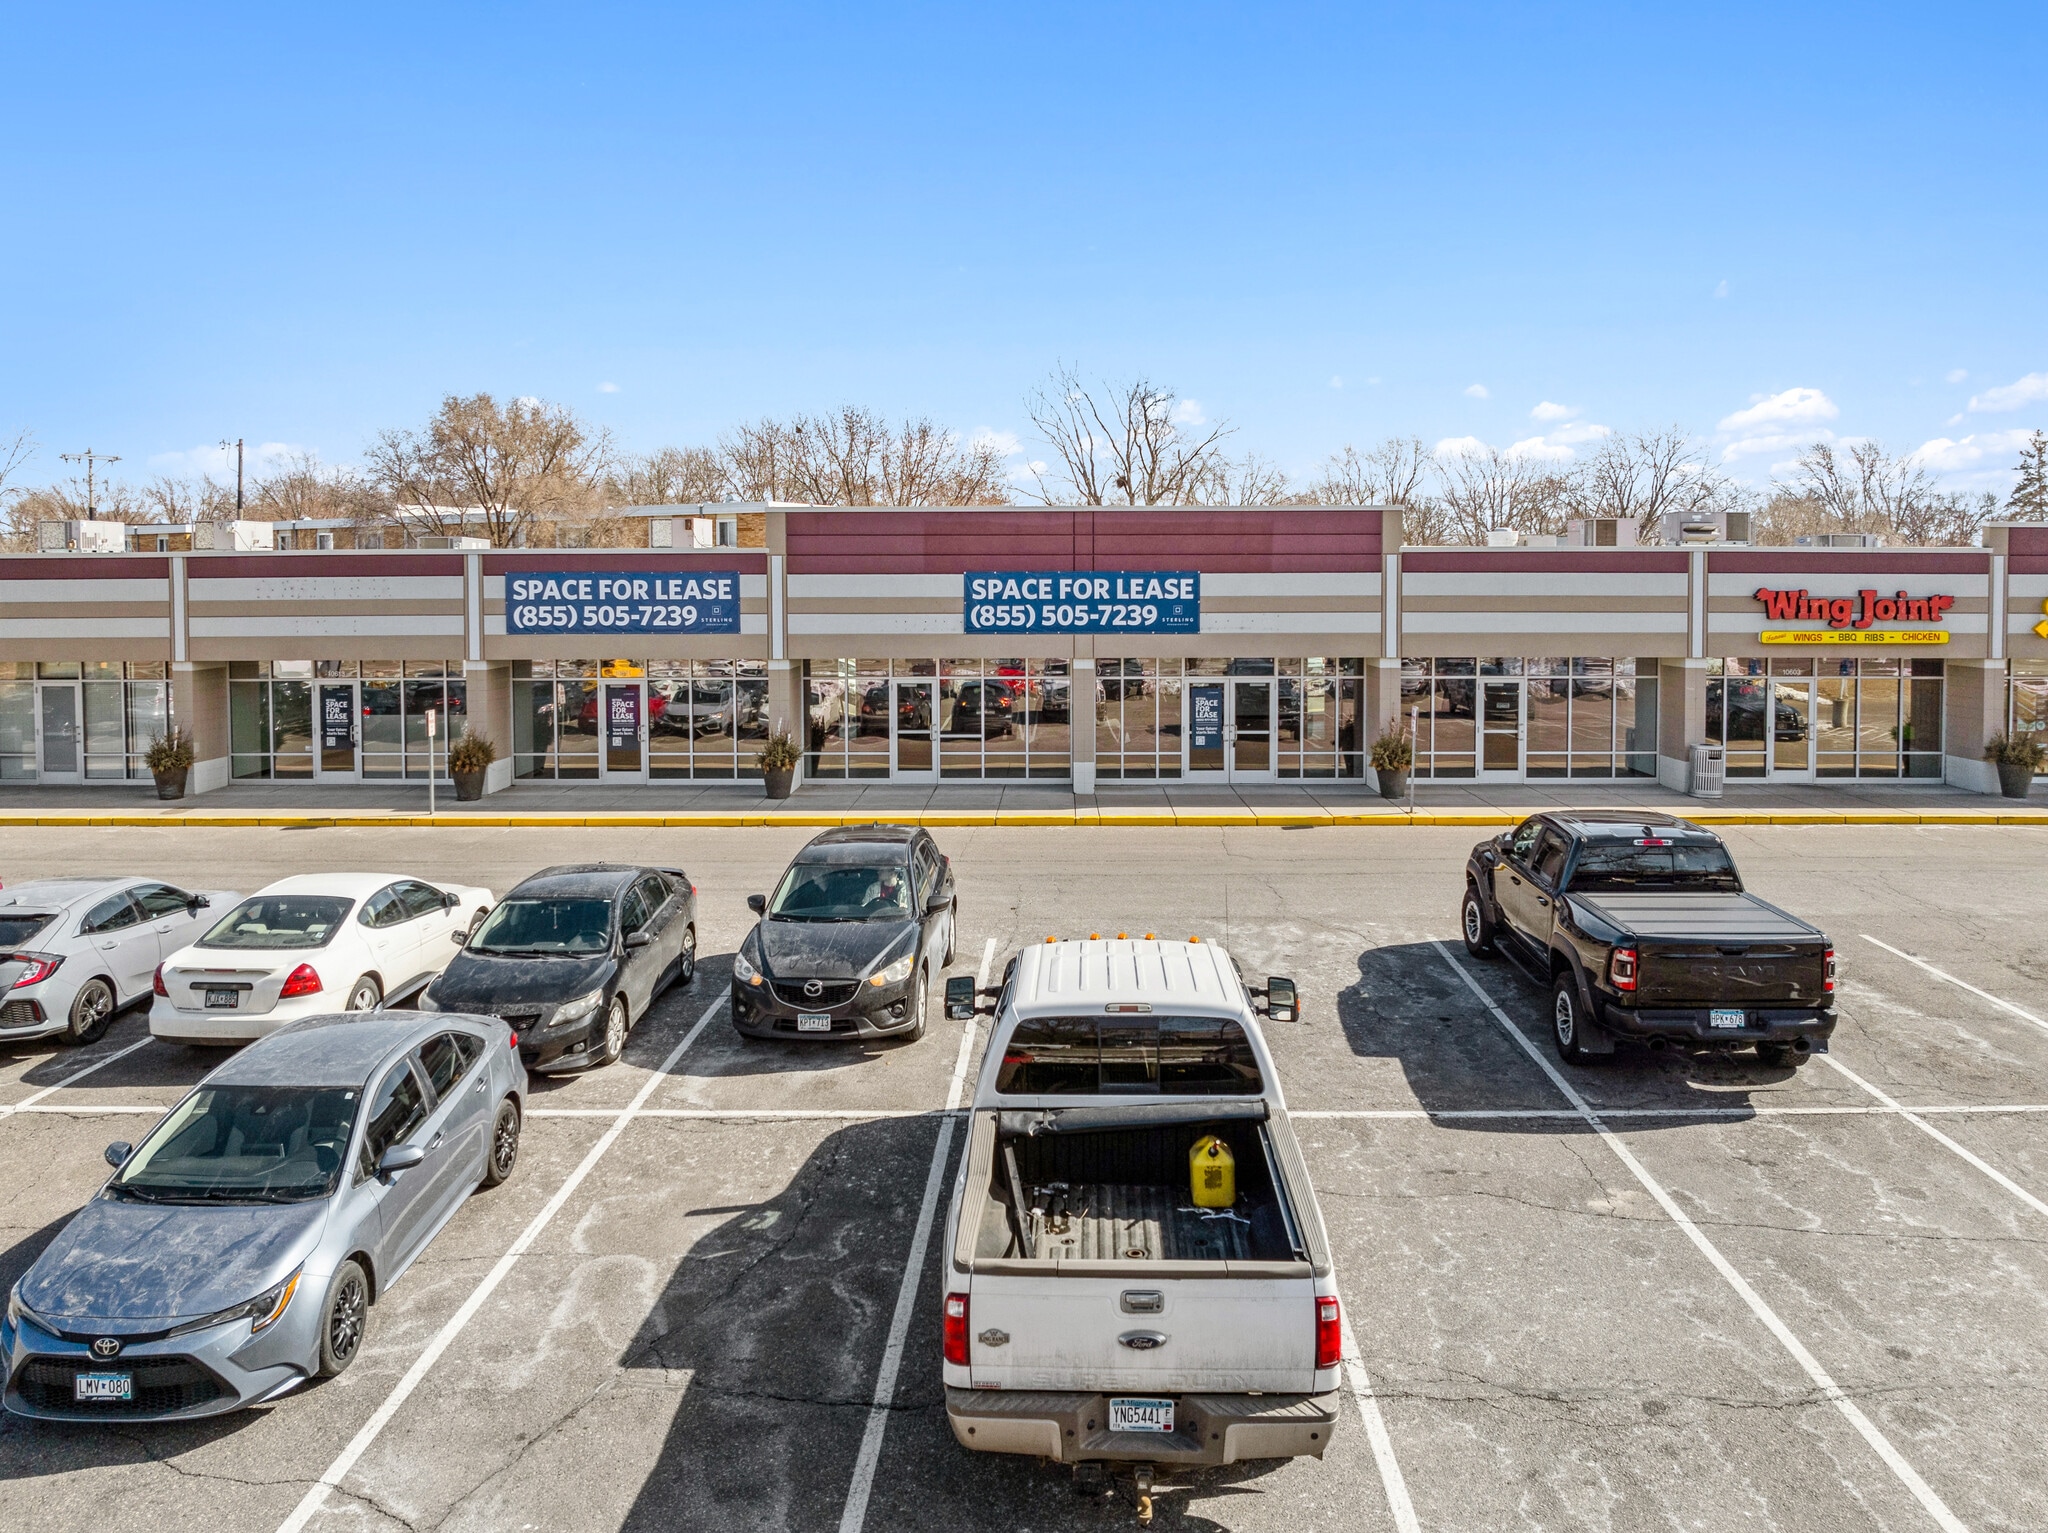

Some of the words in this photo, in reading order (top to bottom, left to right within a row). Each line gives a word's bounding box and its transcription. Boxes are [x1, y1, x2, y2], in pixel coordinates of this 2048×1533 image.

[513, 579, 592, 600] SPACE
[599, 579, 649, 600] FOR
[656, 579, 732, 600] LEASE
[972, 578, 1052, 600] SPACE
[1059, 578, 1110, 600] FOR
[1116, 578, 1194, 600] LEASE
[1753, 587, 1854, 628] Wing
[1852, 588, 1954, 629] Joint
[513, 604, 578, 629] (855)
[583, 605, 697, 627] 505-7239
[970, 604, 1036, 629] (855)
[1041, 605, 1157, 627] 505-7239
[1793, 633, 1823, 642] WINGS
[1838, 633, 1857, 642] BBQ
[1864, 633, 1885, 641] RIBS
[1901, 633, 1941, 641] CHICKEN
[800, 1019, 812, 1027] KPT
[816, 1019, 829, 1027] 713
[1711, 1014, 1725, 1024] HPK
[1729, 1014, 1743, 1024] 678
[1132, 1338, 1153, 1348] Ford
[79, 1379, 99, 1394] LMV
[108, 1379, 130, 1394] 080
[1032, 1373, 1140, 1388] SUPER
[1167, 1374, 1248, 1389] DUTY
[1113, 1407, 1161, 1424] YNG5441
[1165, 1408, 1171, 1417] F
